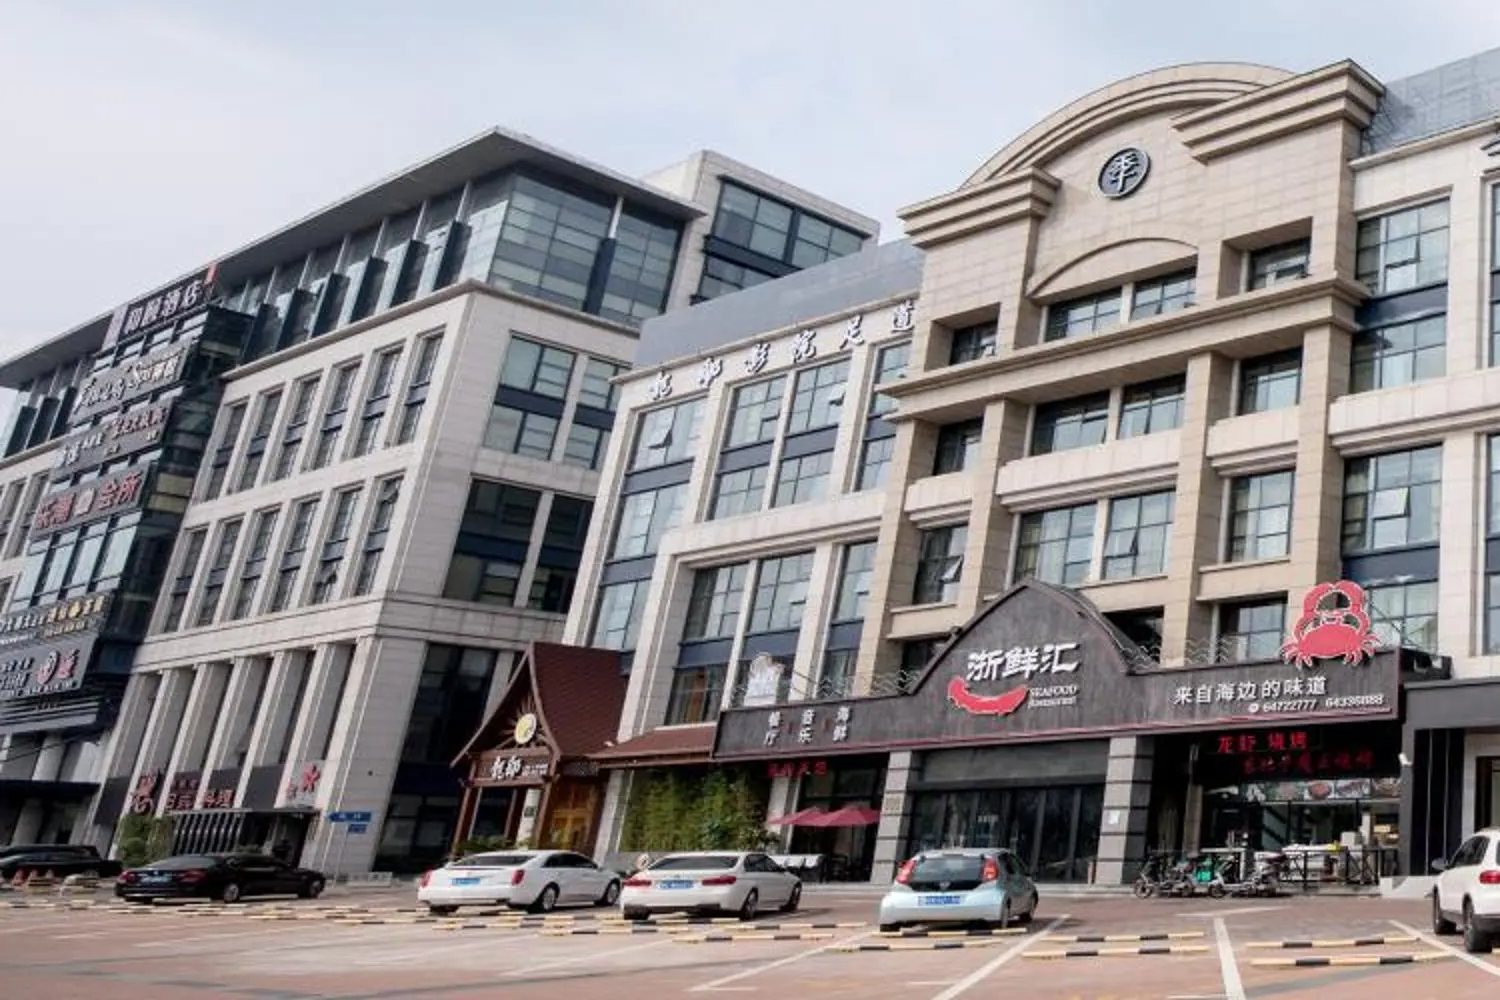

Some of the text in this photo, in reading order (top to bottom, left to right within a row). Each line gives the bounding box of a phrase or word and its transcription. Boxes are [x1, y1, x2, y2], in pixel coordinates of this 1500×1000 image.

[965, 642, 1079, 681] 浙鲜汇
[1173, 676, 1328, 705] 来自海边的味道
